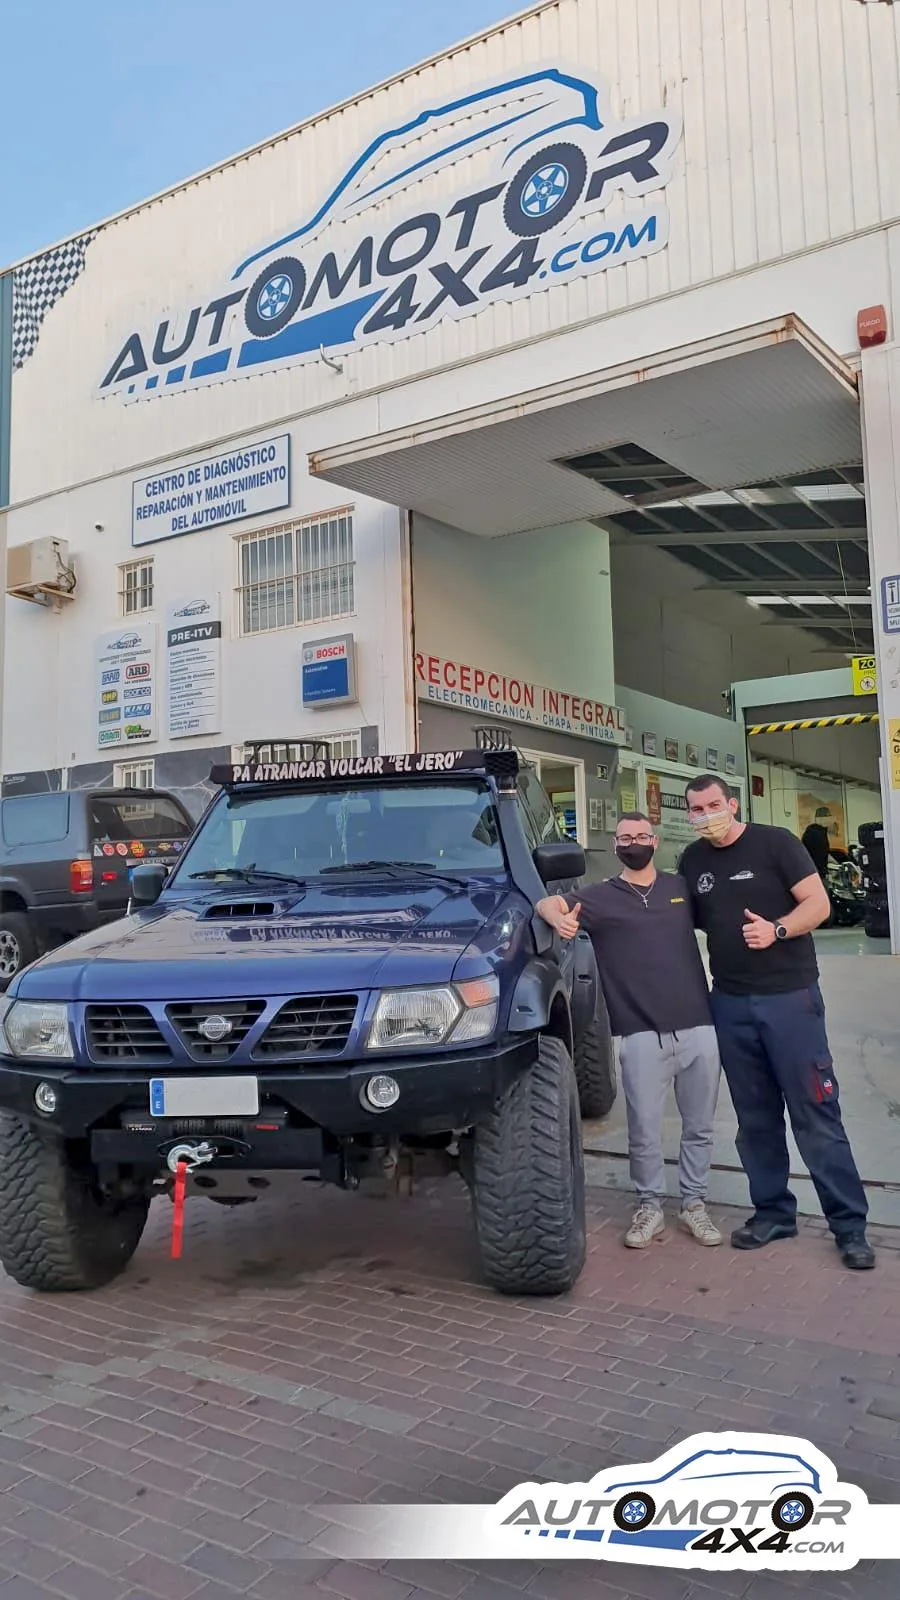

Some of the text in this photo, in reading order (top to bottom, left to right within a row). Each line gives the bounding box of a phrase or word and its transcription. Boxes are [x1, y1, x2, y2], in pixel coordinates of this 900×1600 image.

[100, 121, 670, 388] AUTOMOTOR
[363, 215, 657, 336] 4X4.COM
[136, 465, 286, 521] REPARACIÓN Y MANTENIMIENTO
[145, 445, 276, 497] CENTRO DE DIAGNÓSTICO
[171, 498, 247, 531] DEL AUTOMÓVIL
[171, 626, 213, 642] PRE-ITV
[316, 645, 345, 659] BOSCH
[128, 665, 148, 677] ARB
[416, 653, 625, 731] RECEPCION INTEGRAL
[428, 685, 615, 740] ELECTROMECANICA CHAPA PINTURA
[232, 765, 250, 782] PA
[254, 760, 326, 781] ATRANCAR
[330, 756, 384, 776] VOLCAR
